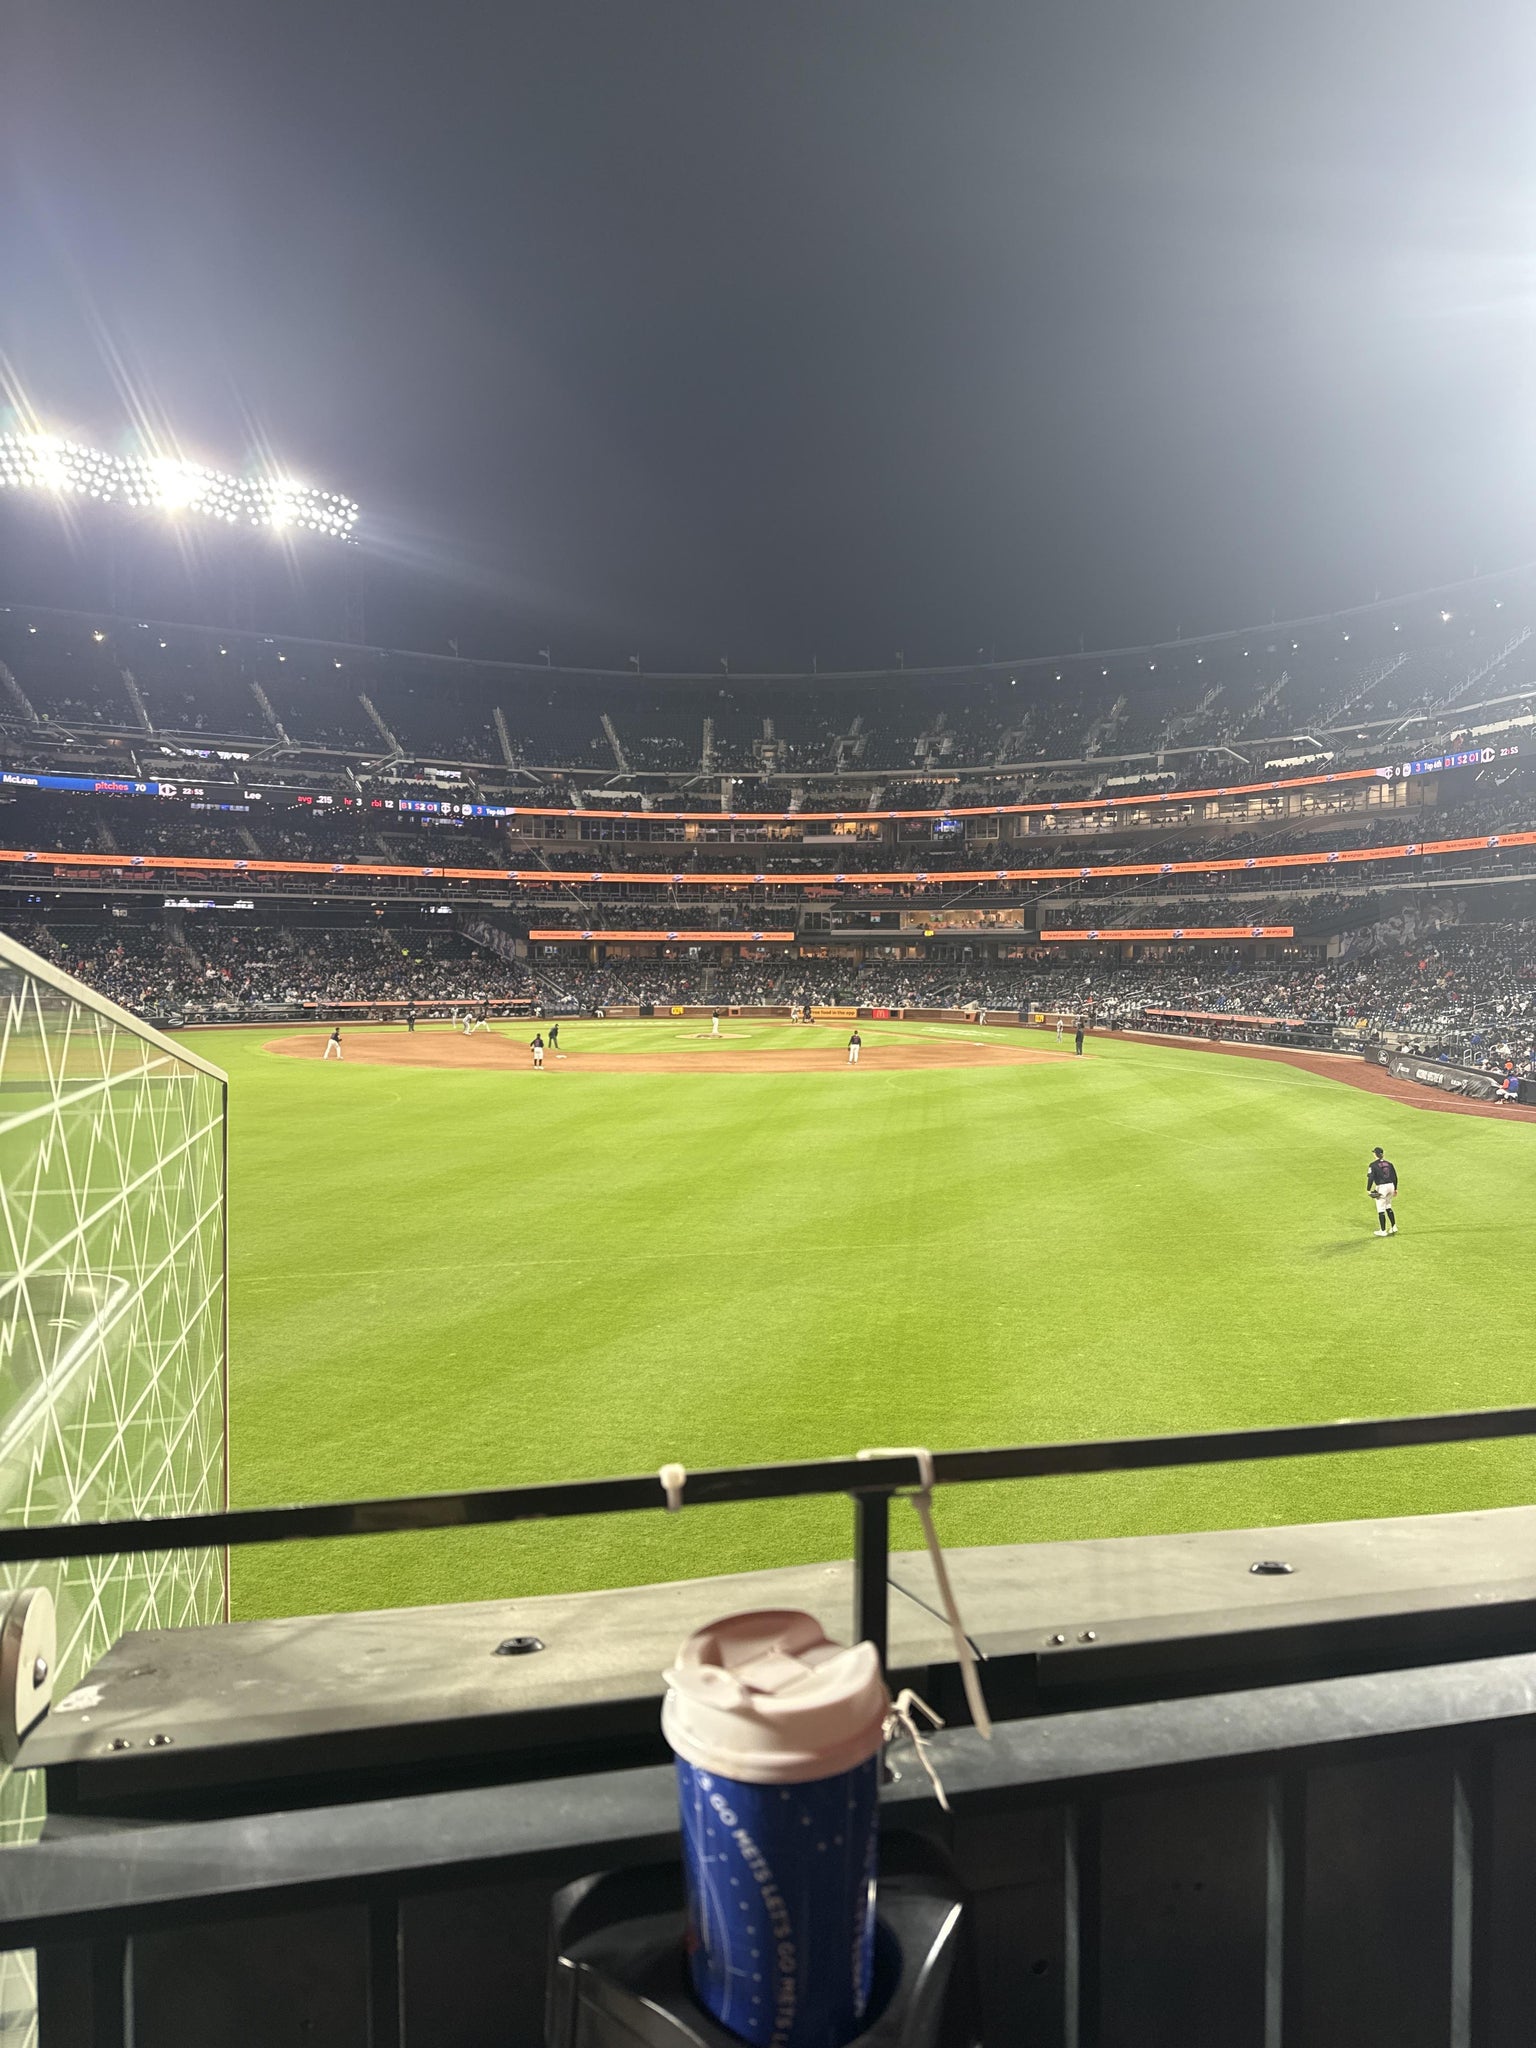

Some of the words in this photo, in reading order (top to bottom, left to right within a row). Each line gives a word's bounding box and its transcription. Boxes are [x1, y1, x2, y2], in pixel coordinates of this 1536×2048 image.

[3, 774, 38, 785] McLean
[95, 782, 129, 791] pitches
[134, 783, 147, 792] 70
[244, 791, 262, 800] Lee
[297, 795, 313, 805] avg
[344, 797, 353, 805] hr
[356, 798, 362, 806] 3
[371, 799, 382, 808] rbi
[384, 800, 394, 808] 12
